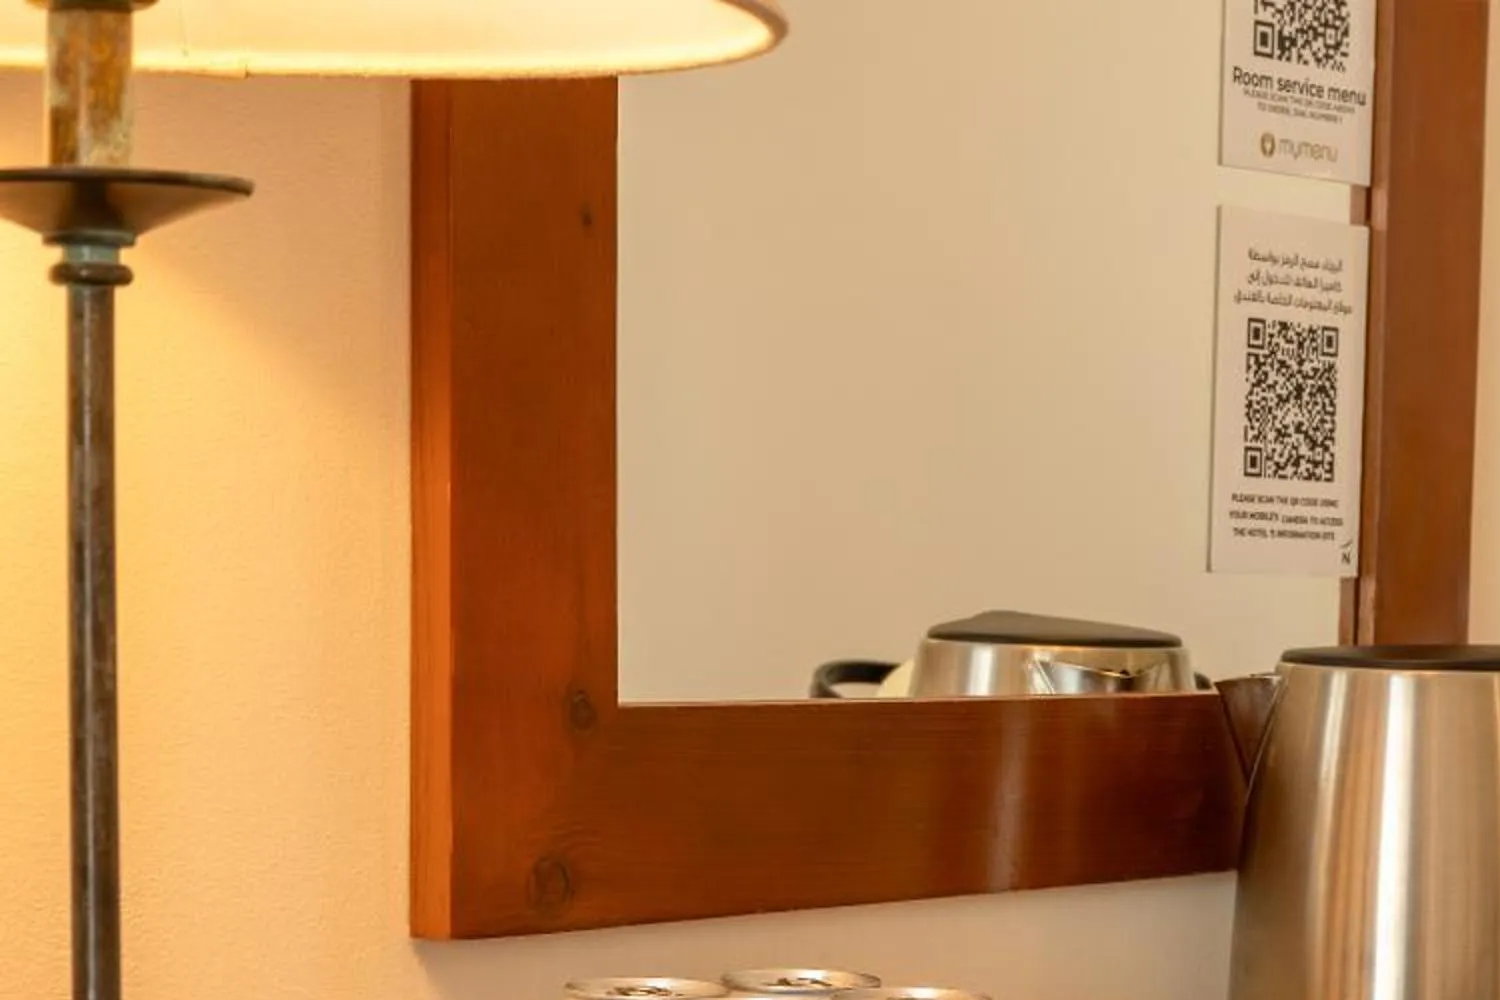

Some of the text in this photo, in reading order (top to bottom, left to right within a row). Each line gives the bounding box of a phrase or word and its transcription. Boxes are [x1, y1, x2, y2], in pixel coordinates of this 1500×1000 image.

[1232, 66, 1367, 106] Room service menu
[1278, 137, 1339, 163] mymenu
[1231, 493, 1255, 503] PLEASE
[1257, 494, 1274, 504] SCAN
[1275, 495, 1288, 505] THE
[1290, 496, 1299, 506] QR
[1299, 497, 1318, 507] CODE
[1229, 510, 1248, 519] YOUR
[1281, 515, 1308, 525] CAMERA
[1309, 516, 1319, 526] TO
[1319, 517, 1343, 527] ACCESS
[1233, 527, 1246, 538] THE
[1321, 531, 1335, 541] SITE
